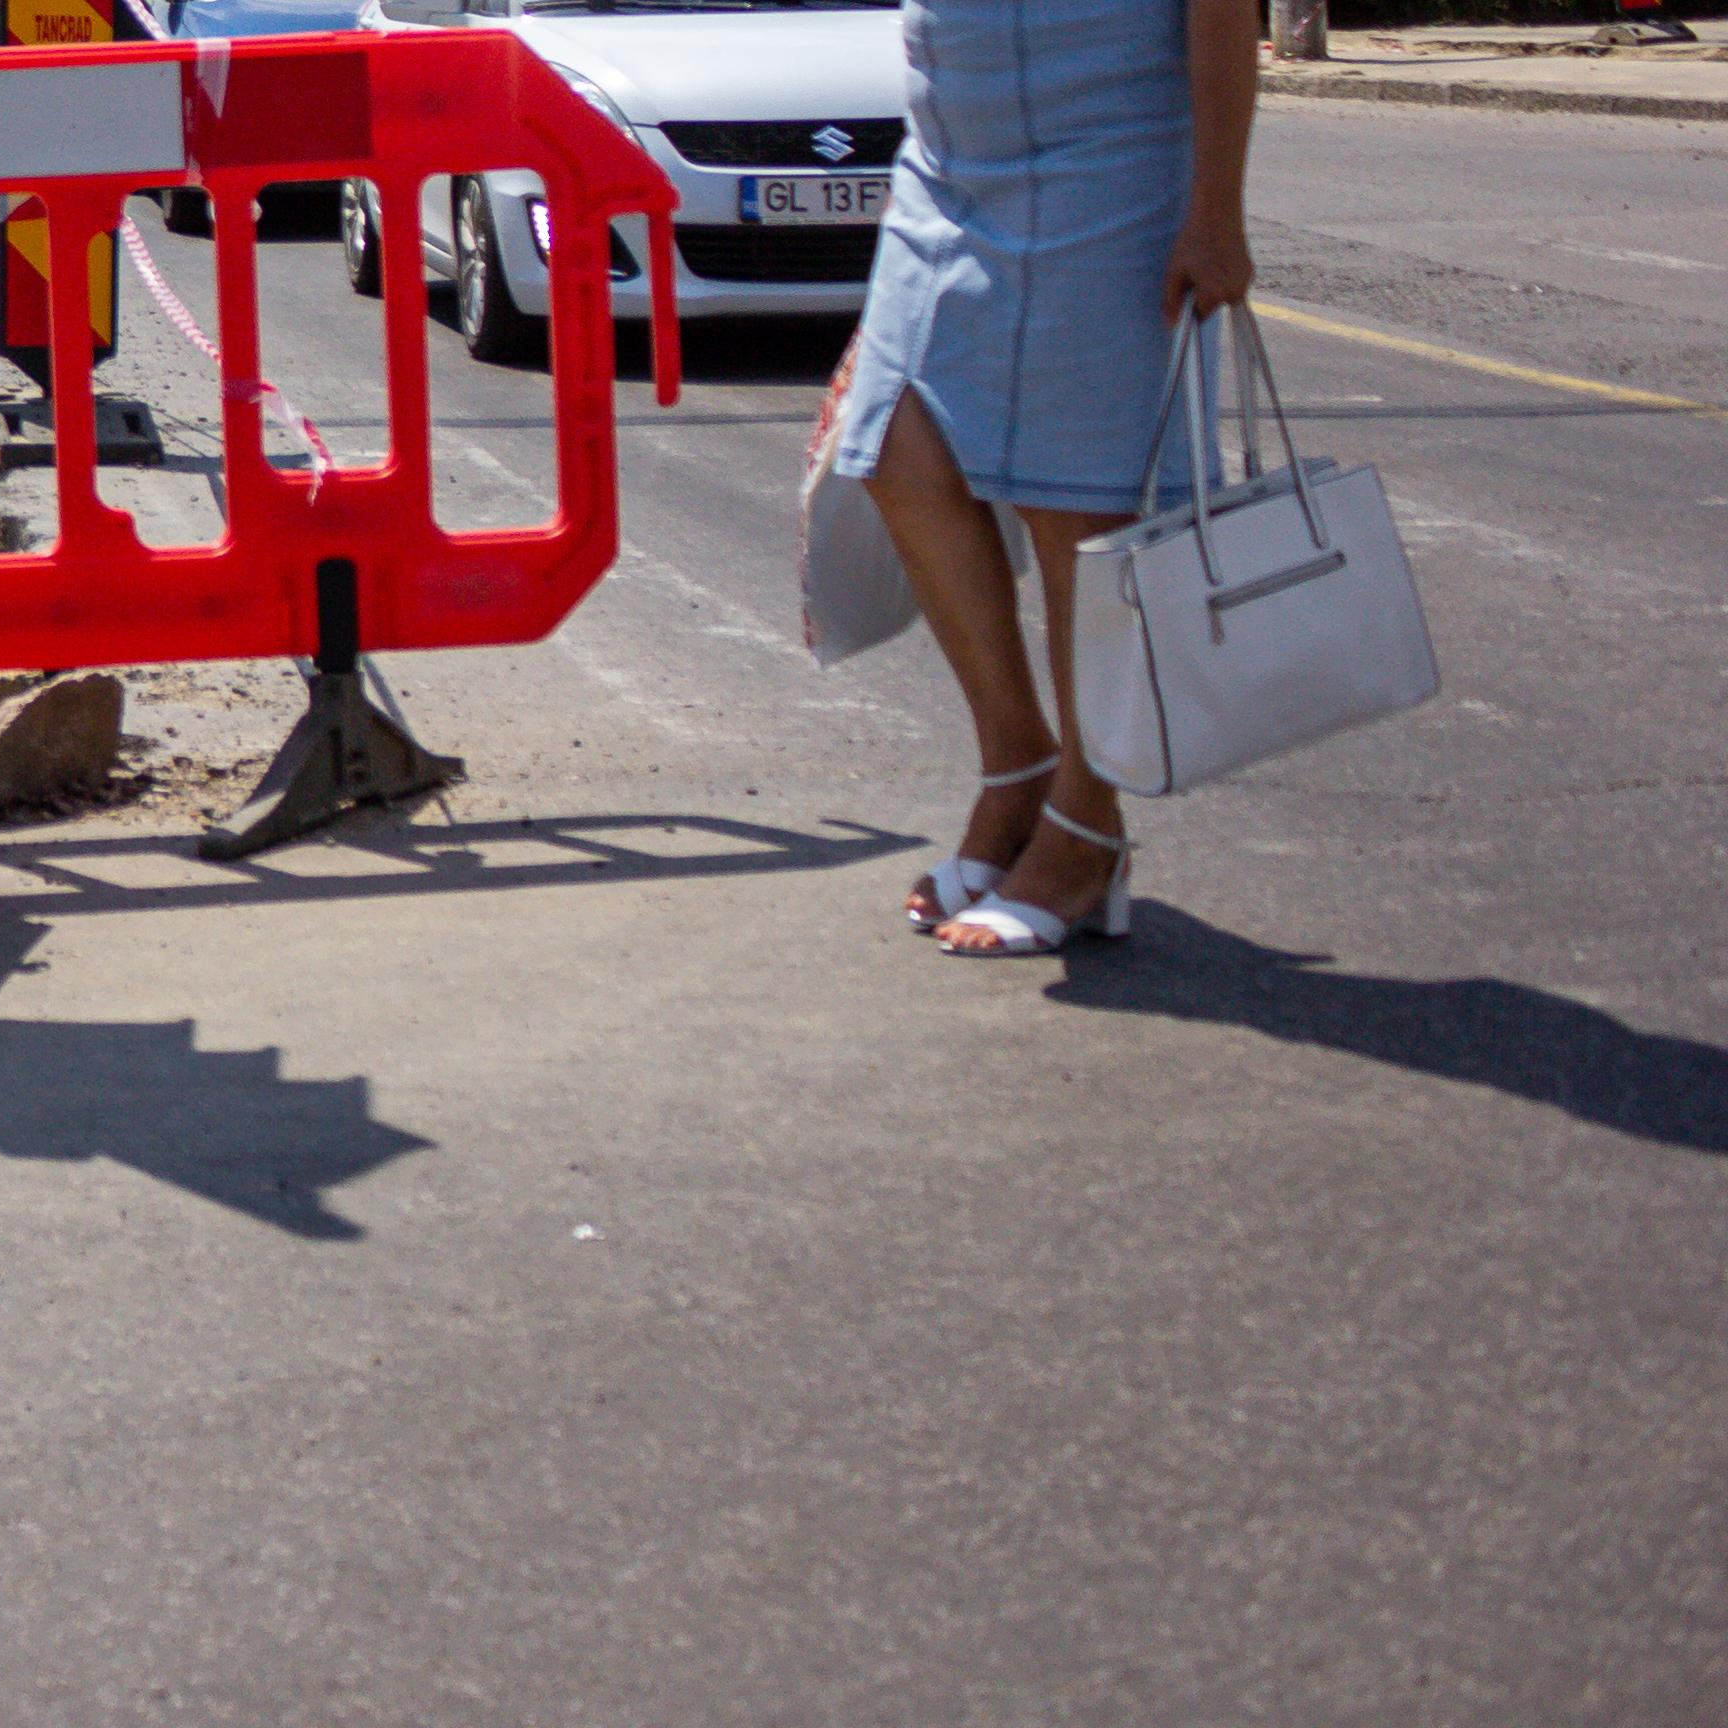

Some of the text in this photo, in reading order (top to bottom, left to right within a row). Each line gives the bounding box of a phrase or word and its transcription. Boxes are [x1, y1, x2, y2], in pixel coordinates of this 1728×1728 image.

[34, 14, 93, 42] TANCRAD
[765, 180, 891, 213] GL 13 F
